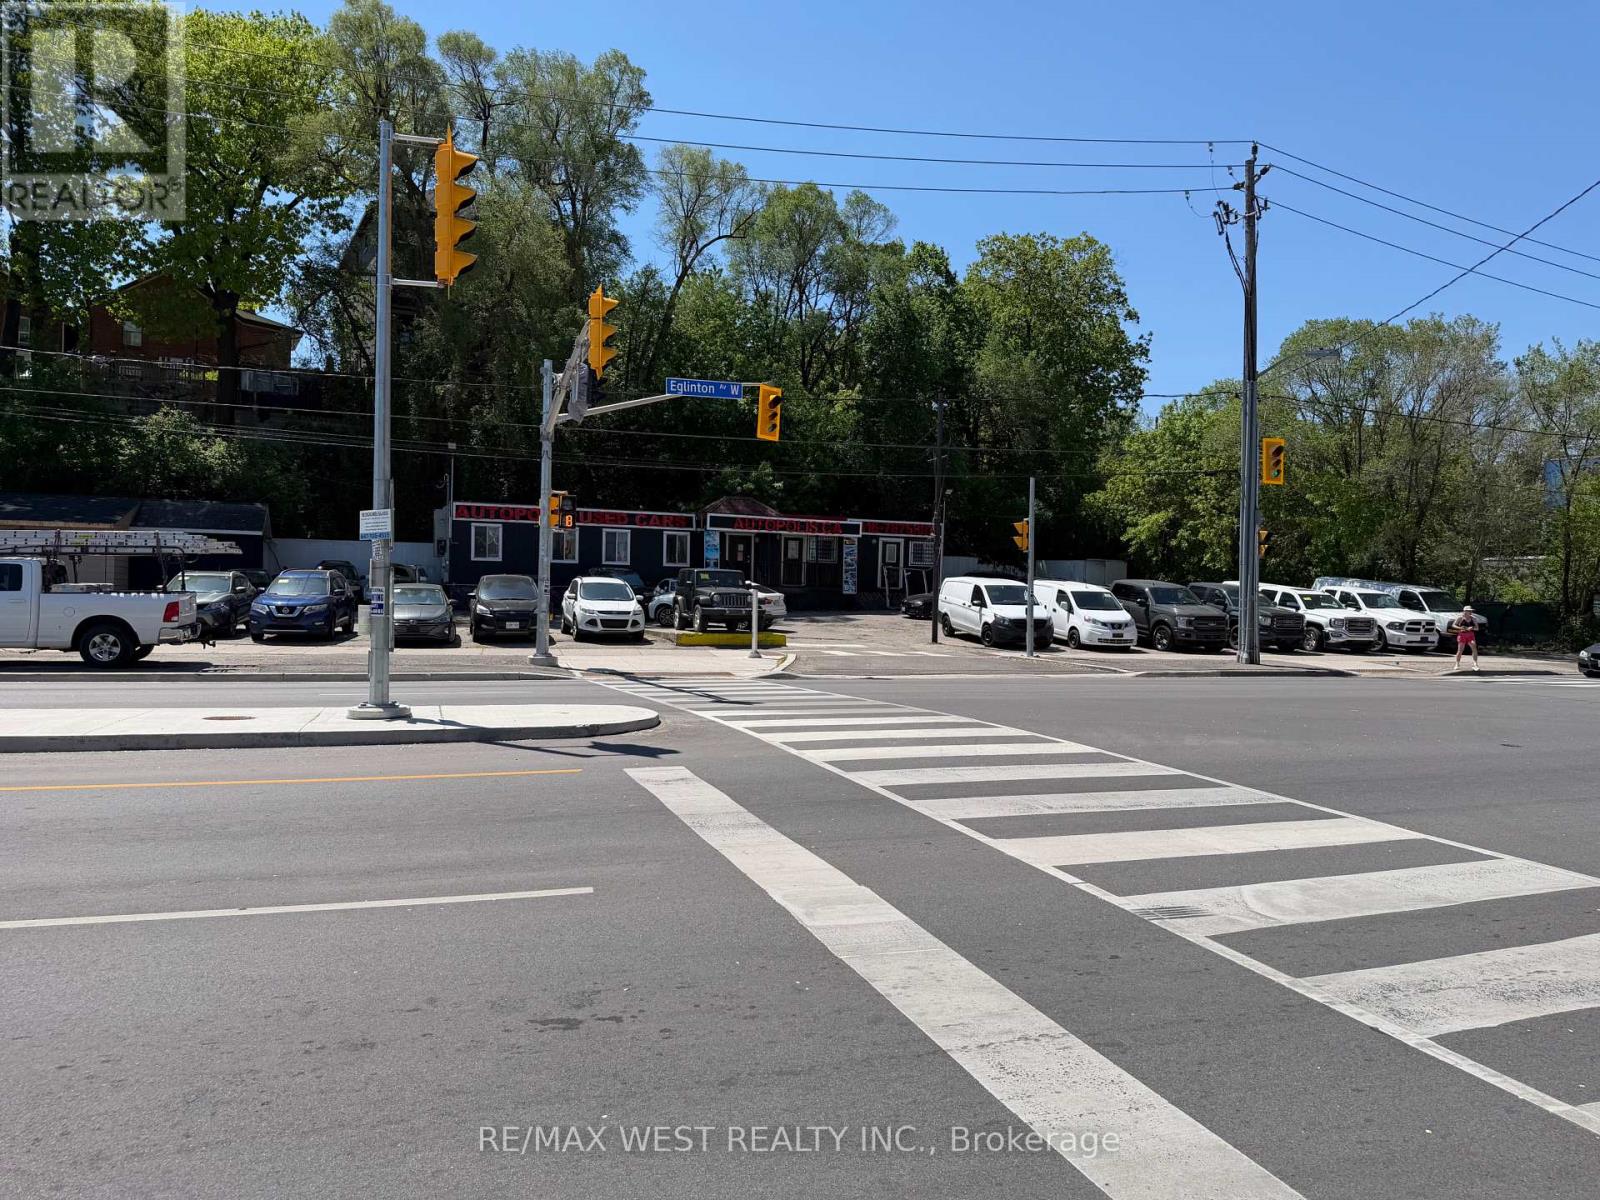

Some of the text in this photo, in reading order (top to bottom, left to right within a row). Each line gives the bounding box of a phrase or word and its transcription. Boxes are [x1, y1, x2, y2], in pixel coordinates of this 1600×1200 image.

[670, 380, 715, 394] Eglinton
[730, 384, 740, 396] W
[455, 505, 688, 528] AUTOPO USED CARS
